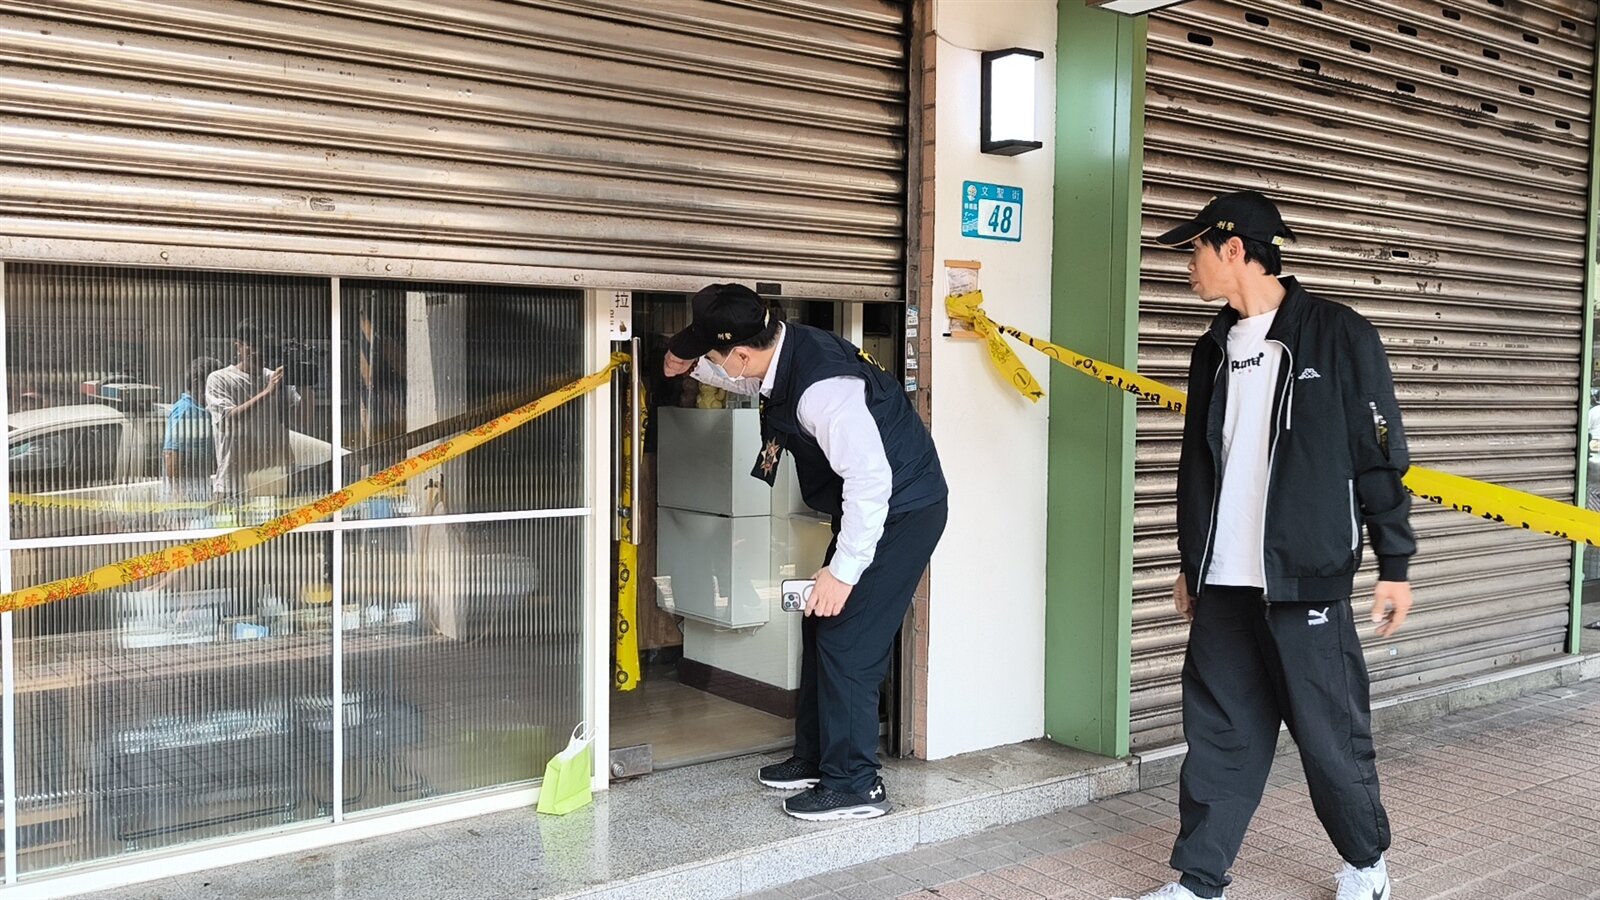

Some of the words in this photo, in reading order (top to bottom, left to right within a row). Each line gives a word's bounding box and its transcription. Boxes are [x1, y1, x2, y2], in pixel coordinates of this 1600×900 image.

[980, 185, 1020, 201] 文聖街
[988, 204, 1013, 233] 48
[615, 291, 629, 308] 拉
